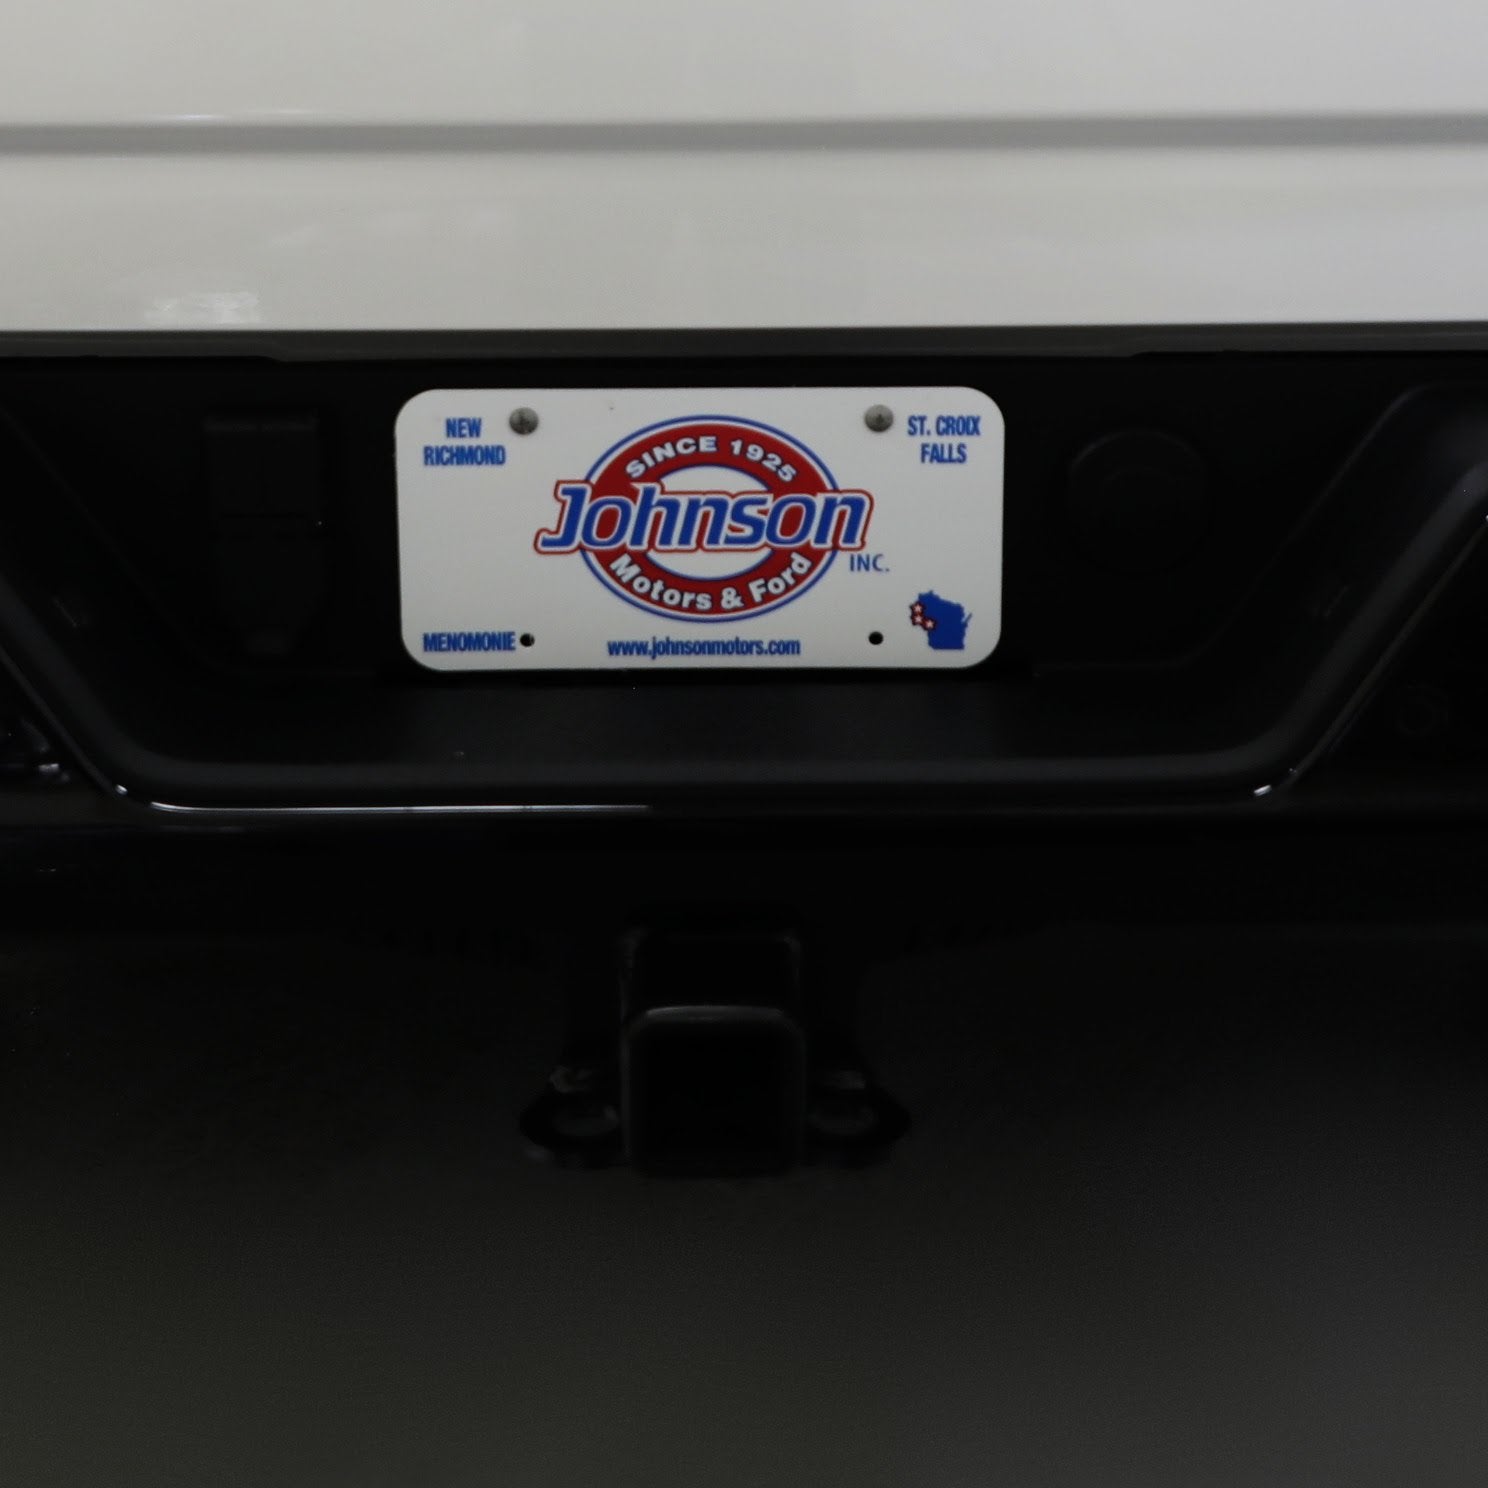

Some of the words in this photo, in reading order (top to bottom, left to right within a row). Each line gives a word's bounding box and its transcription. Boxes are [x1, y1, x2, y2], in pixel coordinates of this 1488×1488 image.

[445, 417, 482, 439] NEW
[907, 415, 931, 437] ST.
[936, 415, 981, 437] CROIX
[423, 444, 507, 467] RICHMOND
[625, 436, 718, 479] SINCE
[730, 438, 798, 483] 1925
[920, 443, 968, 464] FALLS
[537, 482, 870, 552] Johnson
[849, 554, 891, 573] INC.
[609, 553, 713, 610] Motors
[720, 586, 745, 611] &
[747, 551, 813, 603] Ford
[422, 631, 516, 653] MENOMONIE
[607, 635, 802, 660] www.johnsonmotors.com
